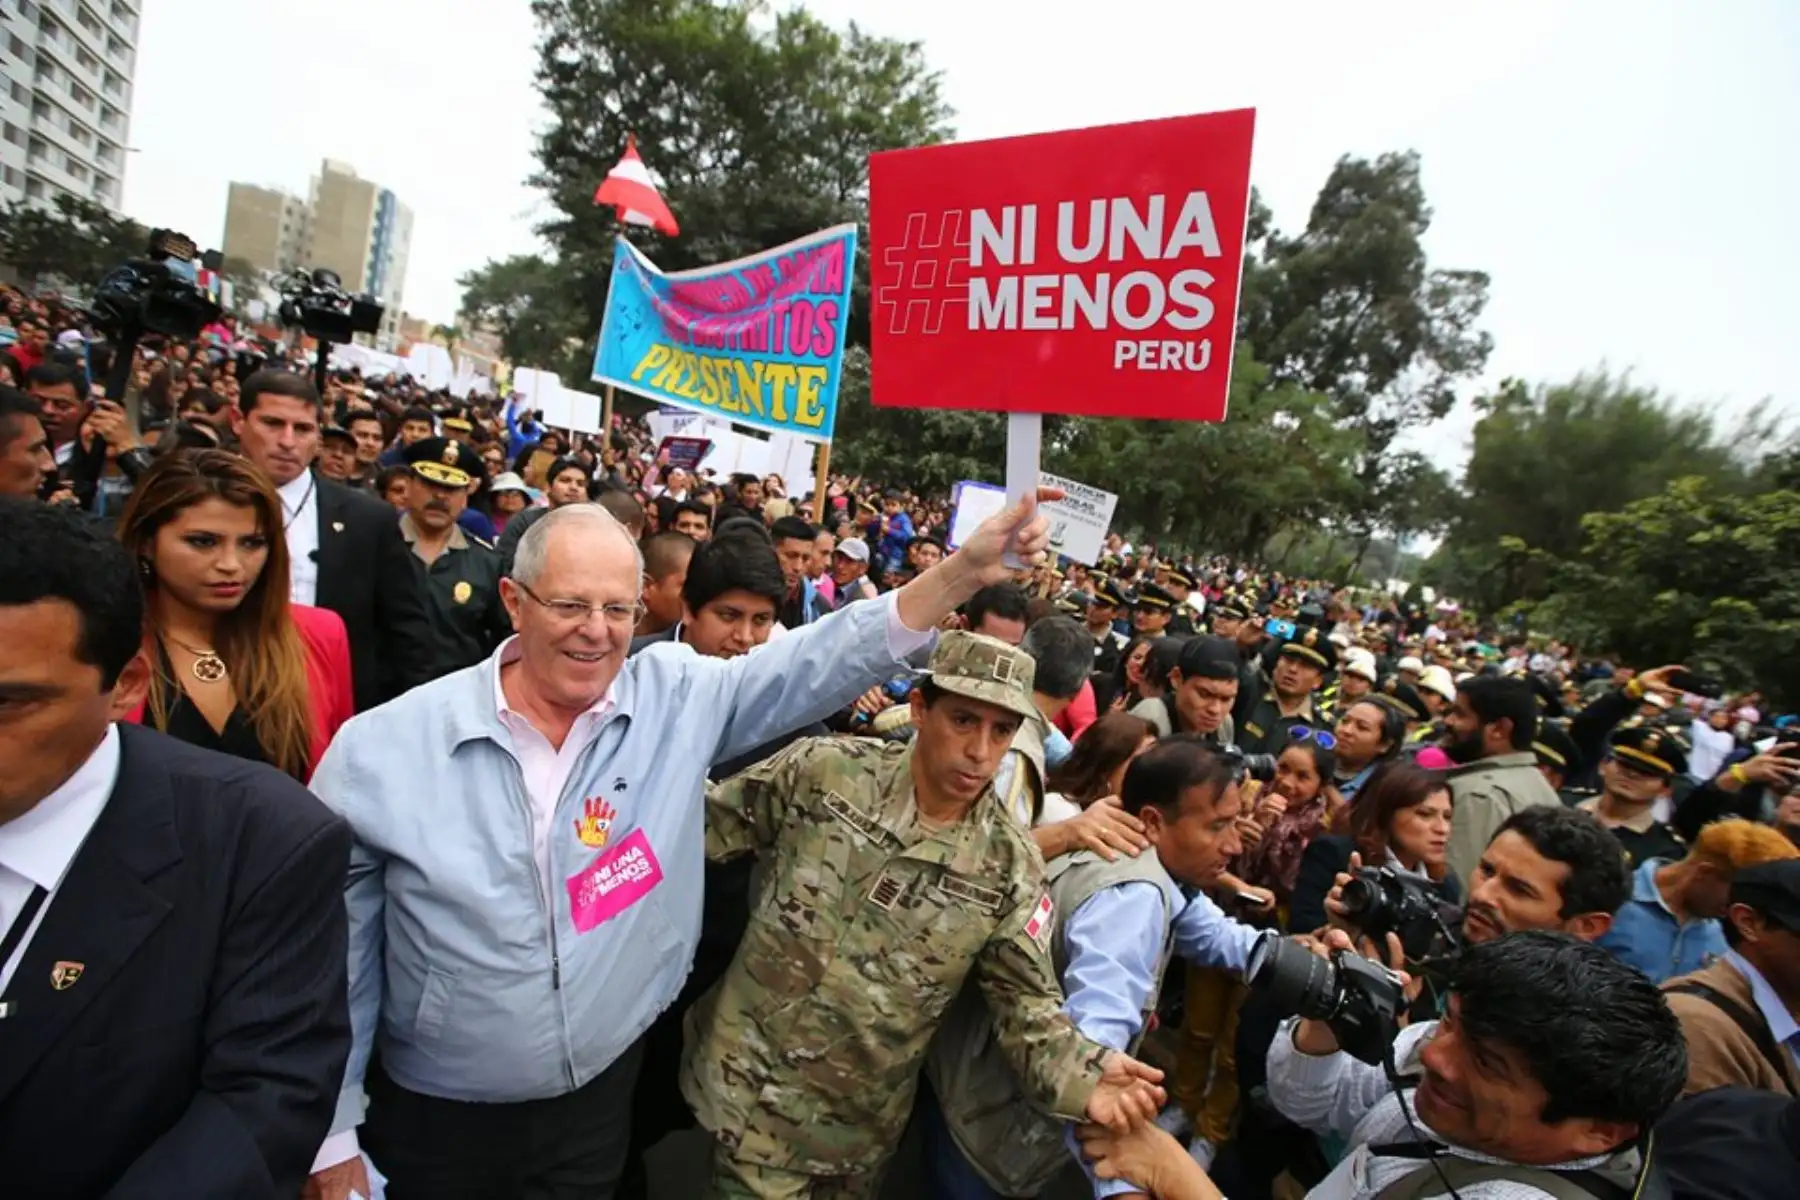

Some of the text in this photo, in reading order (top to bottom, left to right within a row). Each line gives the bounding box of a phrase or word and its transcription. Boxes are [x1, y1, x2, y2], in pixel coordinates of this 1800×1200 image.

[1056, 191, 1223, 264] UNA
[967, 268, 1216, 331] MENOS
[1113, 337, 1212, 371] PERÚ
[630, 344, 828, 427] PRESENTE
[598, 857, 650, 896] MENOS
[612, 846, 645, 872] UNA
